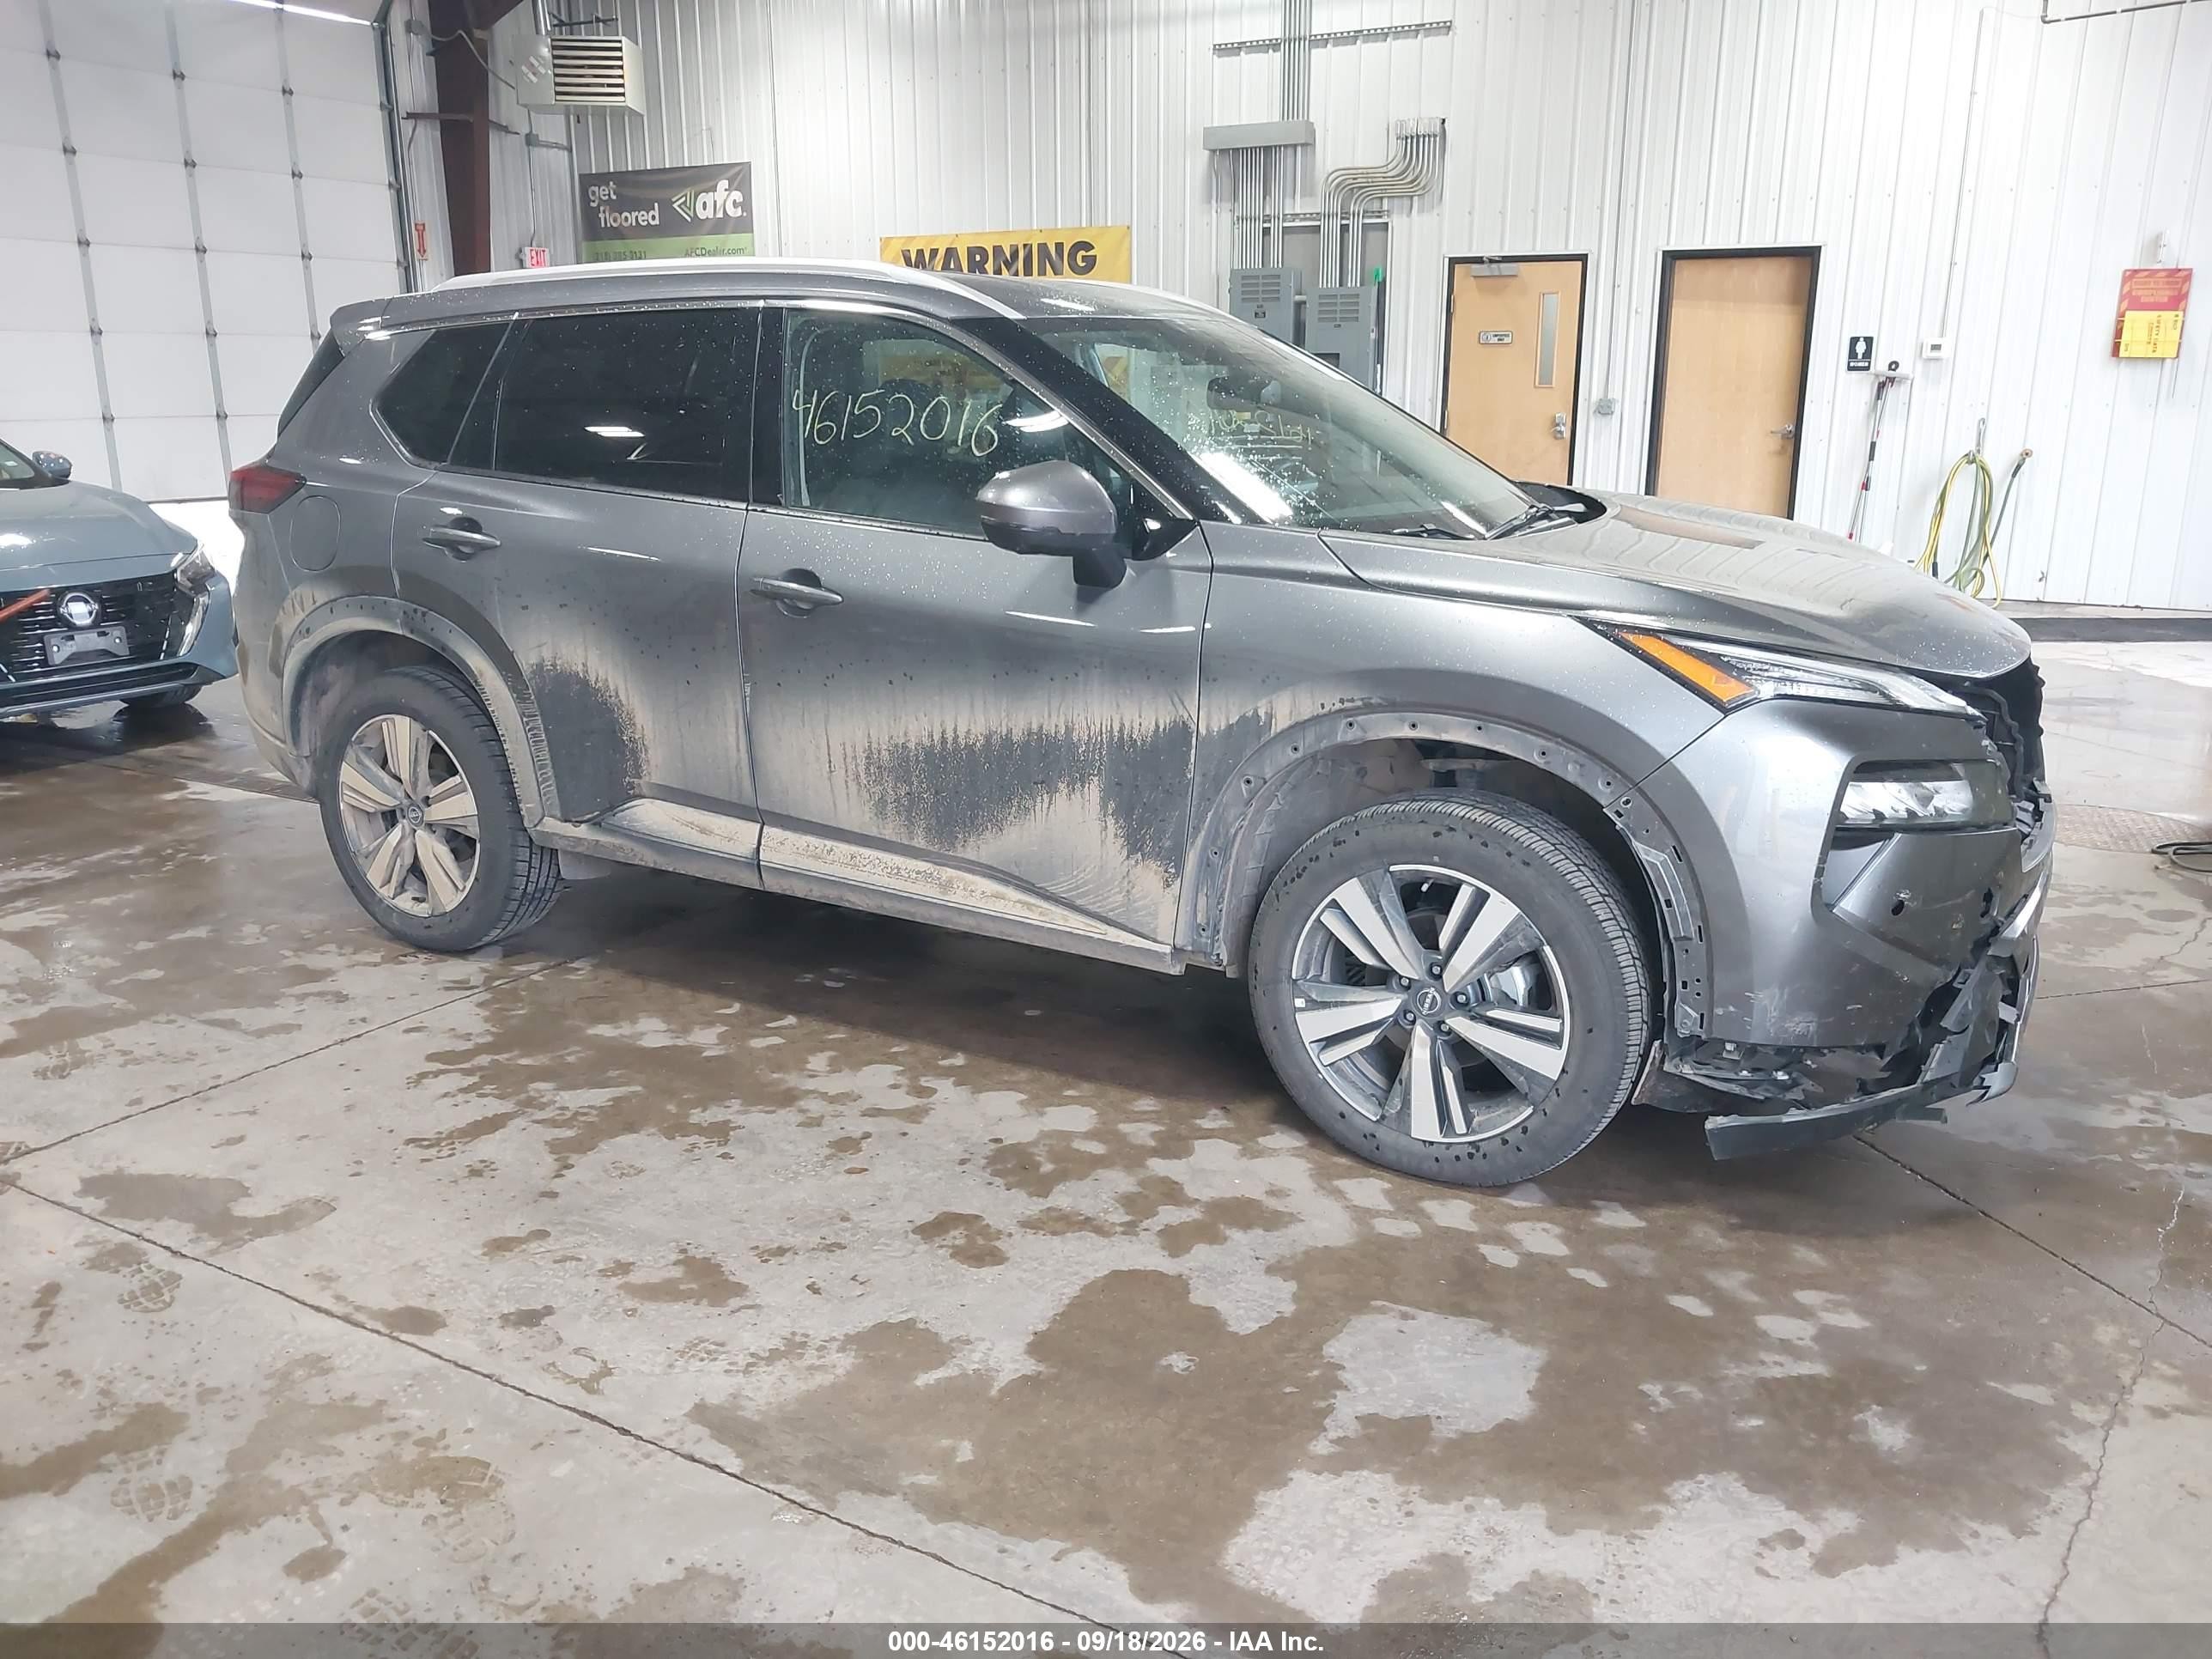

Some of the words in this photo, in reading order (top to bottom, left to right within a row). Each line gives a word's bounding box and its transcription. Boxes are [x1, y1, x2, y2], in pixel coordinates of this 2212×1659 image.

[588, 181, 617, 207] get
[599, 203, 659, 228] floored
[530, 248, 546, 267] EXIT
[901, 240, 1097, 277] WARNING
[792, 390, 1003, 458] 46152016
